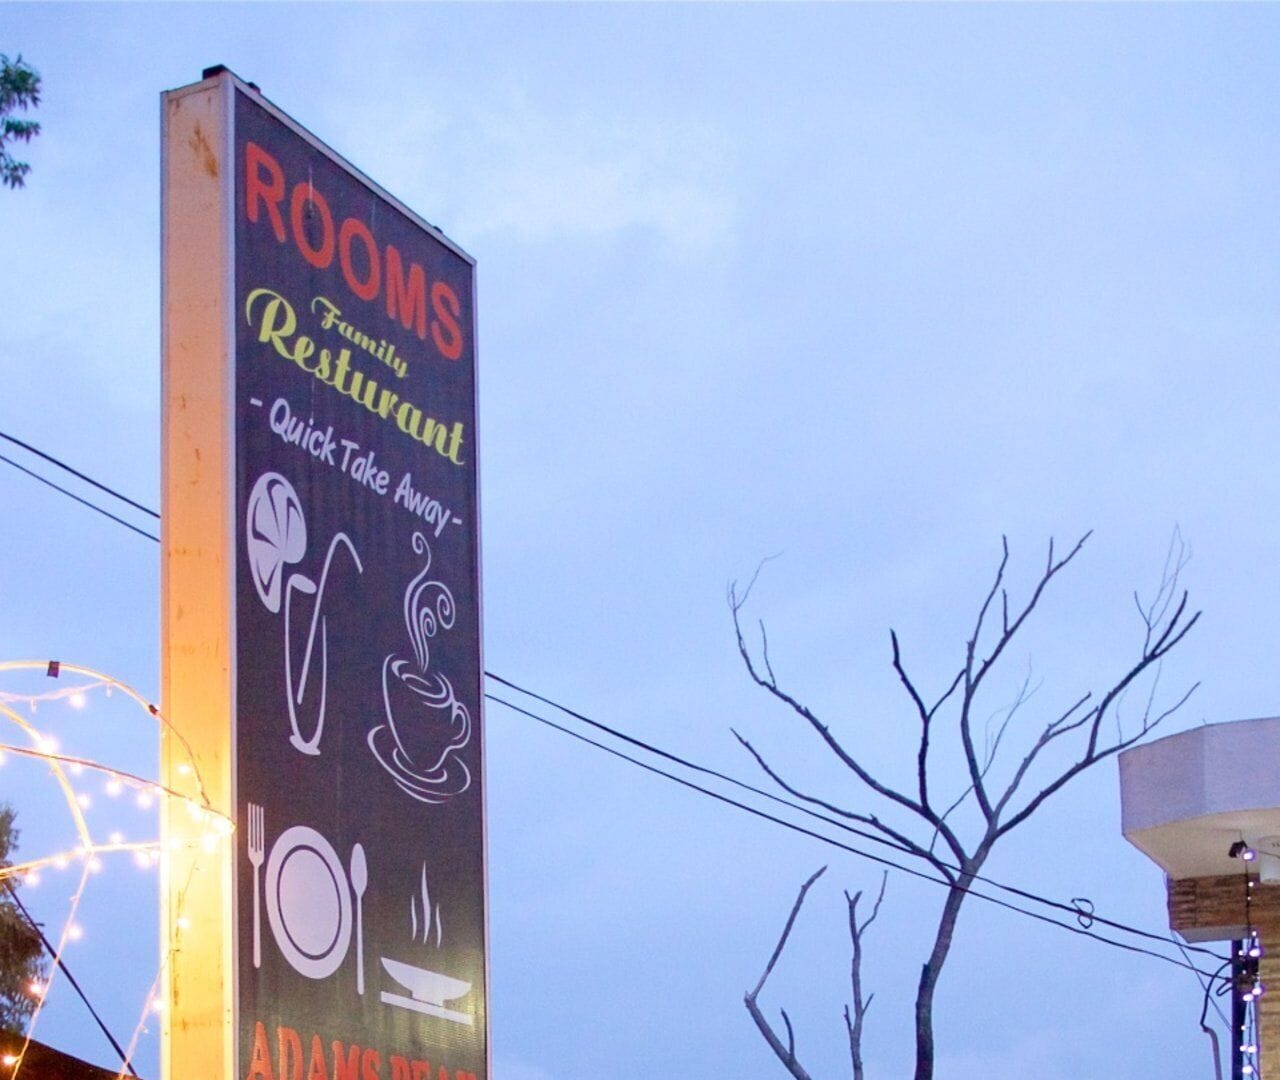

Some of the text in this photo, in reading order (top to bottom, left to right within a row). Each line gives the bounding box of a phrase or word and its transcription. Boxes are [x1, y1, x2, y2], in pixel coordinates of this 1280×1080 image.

[246, 141, 463, 360] ROOMS
[246, 288, 465, 465] Resturant
[311, 297, 409, 379] Family
[339, 439, 390, 496] Take
